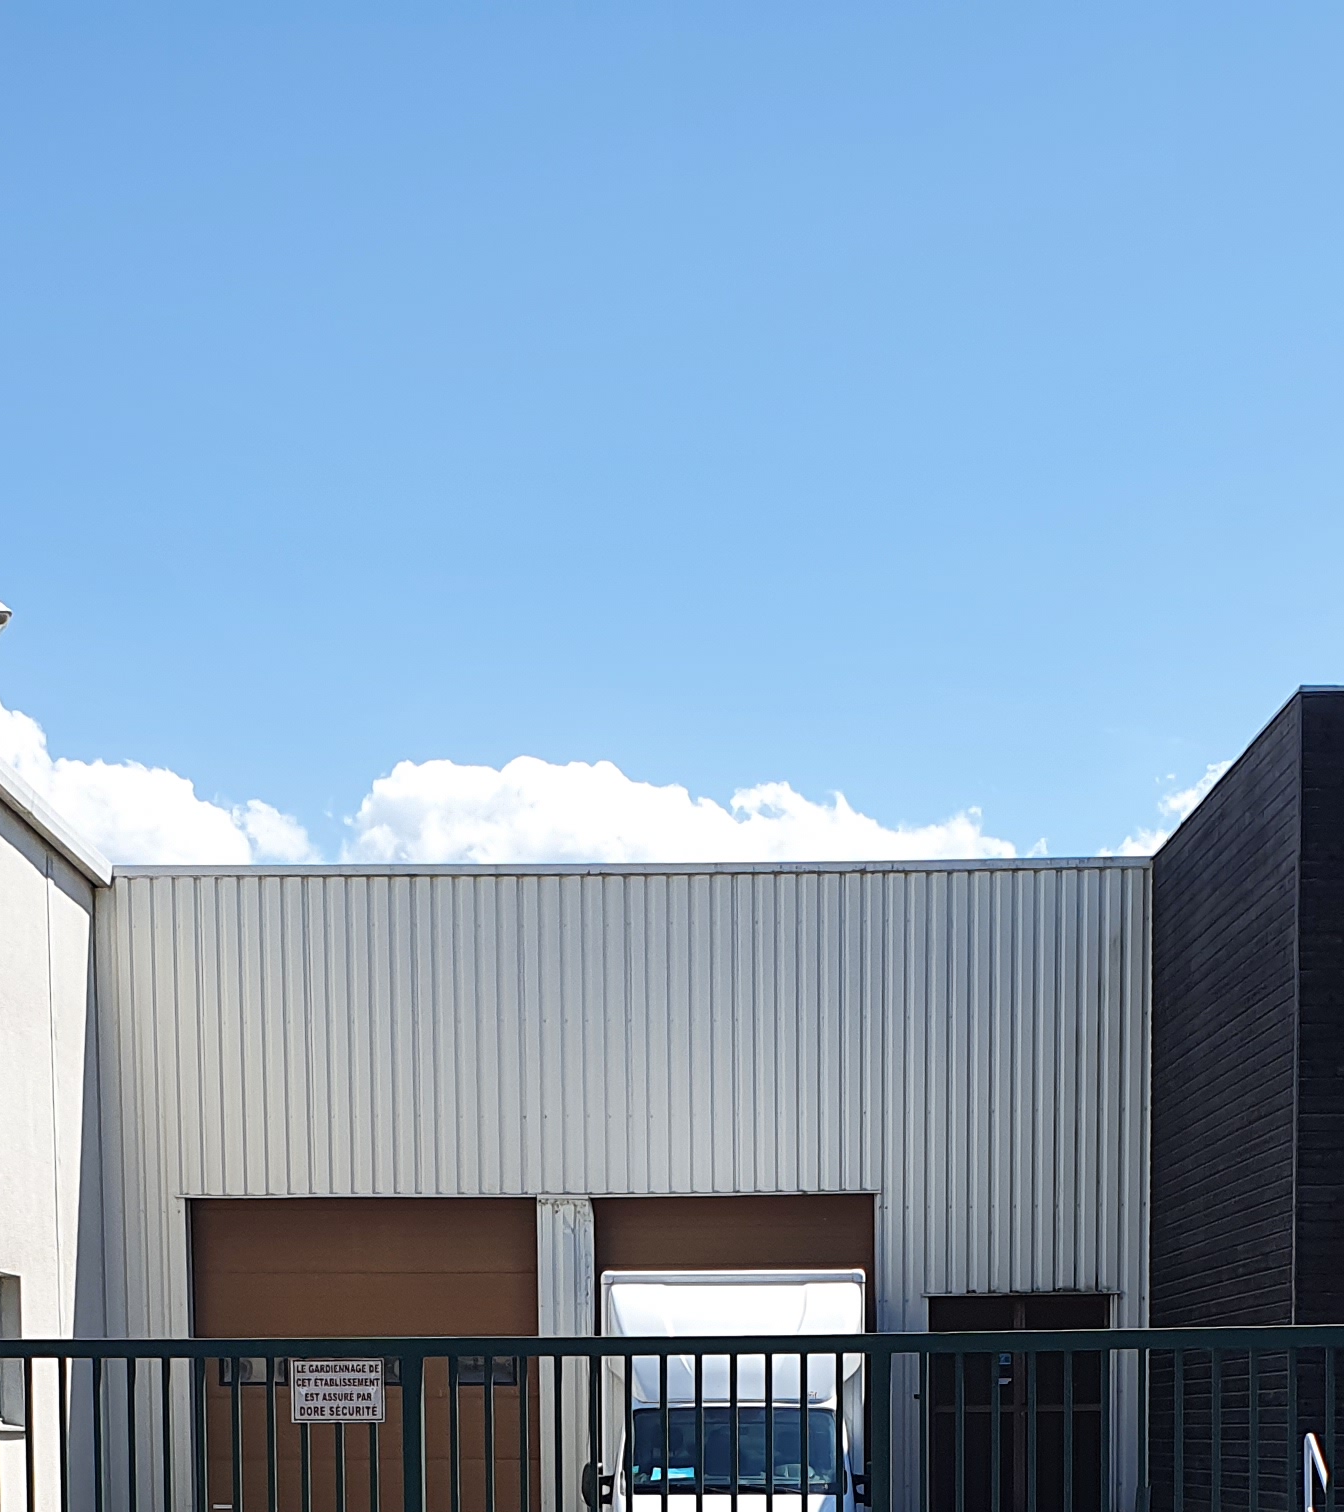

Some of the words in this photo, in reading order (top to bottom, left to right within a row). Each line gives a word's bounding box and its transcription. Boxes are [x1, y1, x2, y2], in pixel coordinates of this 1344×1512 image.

[297, 1364, 306, 1373] LE
[309, 1364, 366, 1373] GARDIENNAGE
[369, 1364, 379, 1373] DE
[296, 1378, 311, 1387] CET
[314, 1376, 380, 1387] ÉTABLISSEMENT
[305, 1393, 319, 1401] EST
[322, 1391, 354, 1401] ASSURÉ
[357, 1393, 372, 1401] PAR
[300, 1406, 325, 1416] DORE
[329, 1404, 377, 1416] SÉCURITÉ
